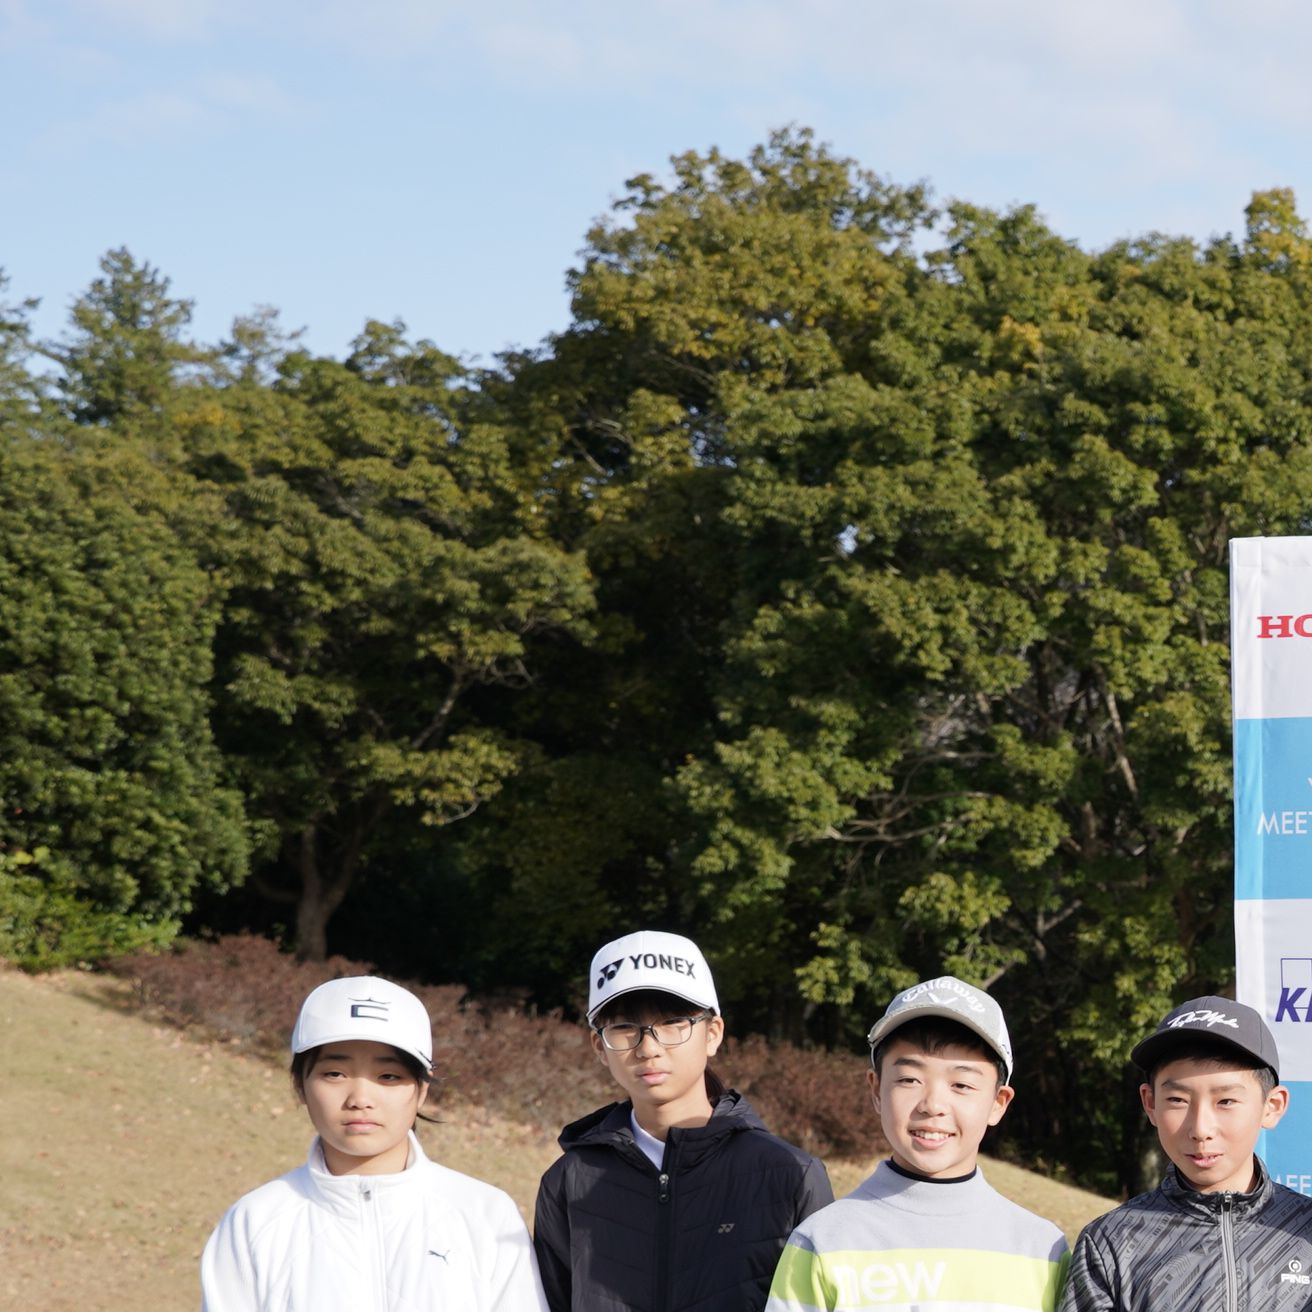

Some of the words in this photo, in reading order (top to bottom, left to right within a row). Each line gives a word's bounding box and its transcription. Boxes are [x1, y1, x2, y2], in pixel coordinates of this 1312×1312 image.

[629, 953, 696, 980] YONEX
[902, 978, 986, 1013] Callaway
[834, 1260, 946, 1303] new
[1281, 1273, 1311, 1284] PING
